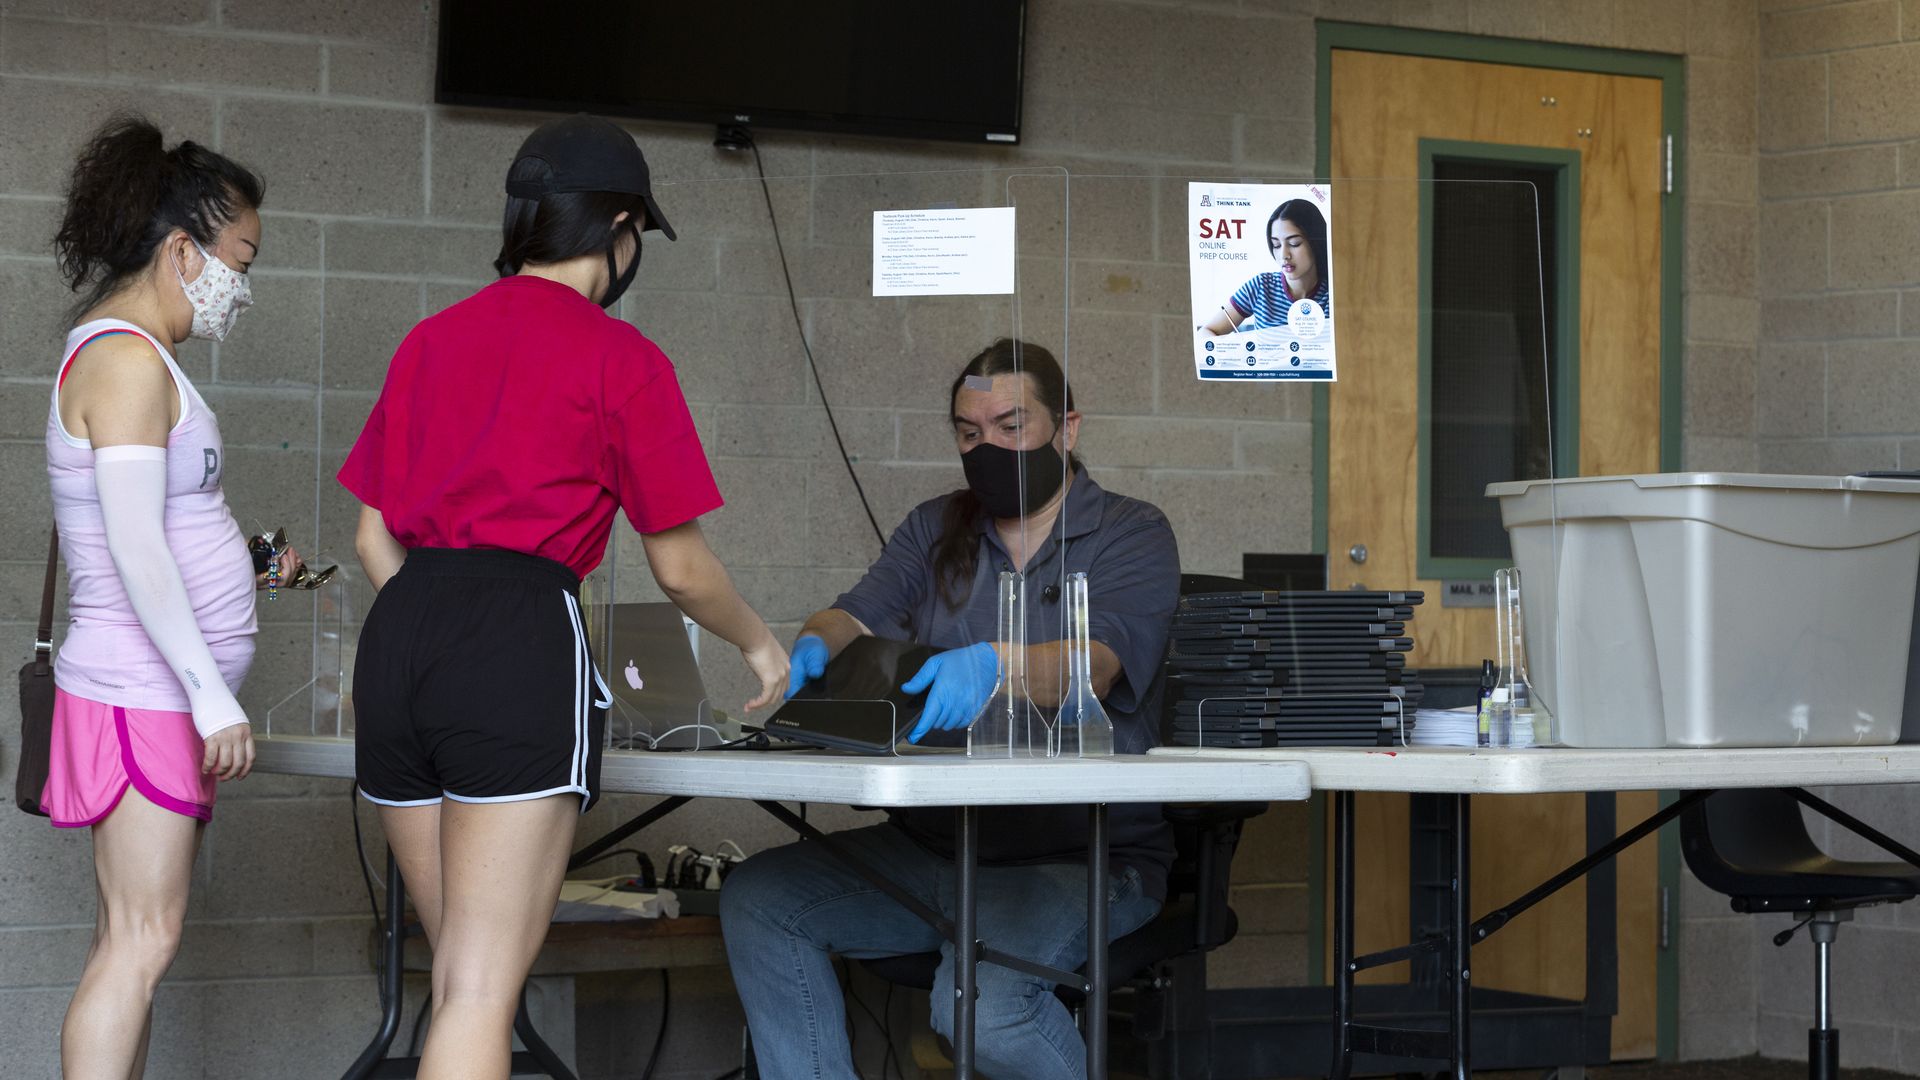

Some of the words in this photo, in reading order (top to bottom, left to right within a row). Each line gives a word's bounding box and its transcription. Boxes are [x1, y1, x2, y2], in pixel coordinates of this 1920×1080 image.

[1199, 218, 1246, 239] SAT
[1199, 252, 1217, 260] PREP
[1218, 252, 1248, 260] COURSE
[200, 447, 223, 489] P
[1450, 584, 1474, 595] MAIL
[1479, 584, 1495, 594] RO
[776, 718, 800, 726] Lenovo
